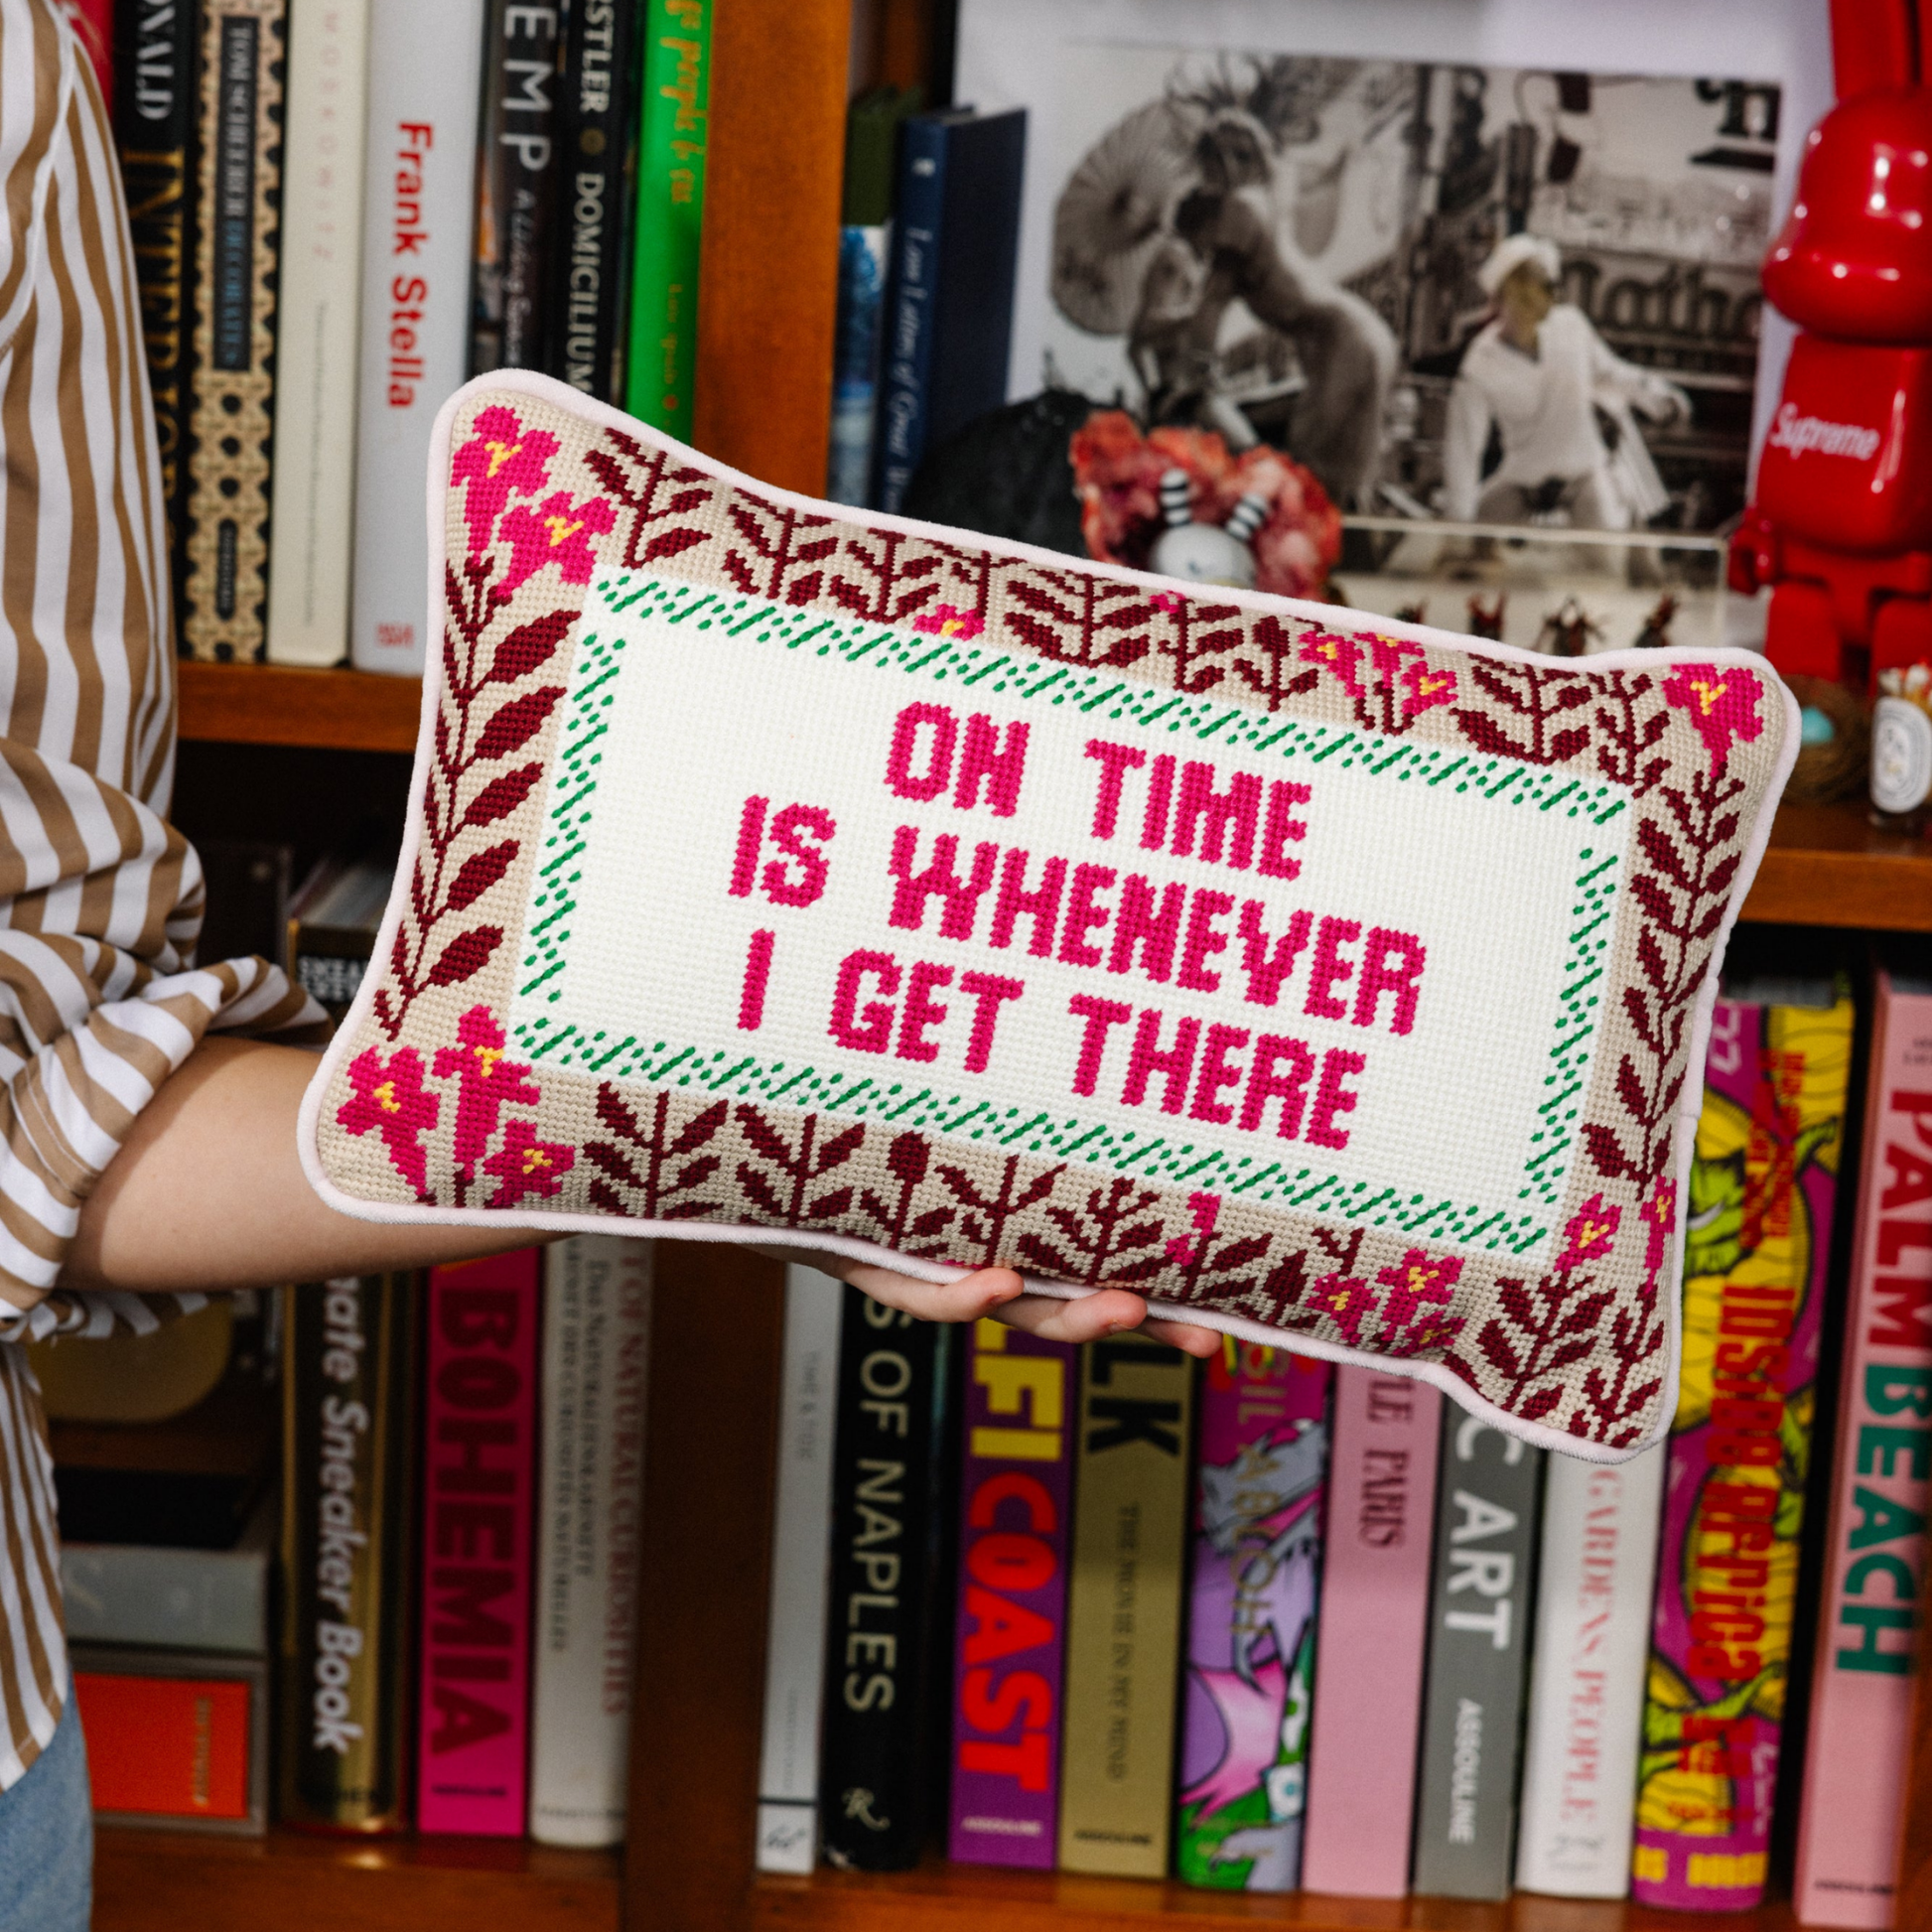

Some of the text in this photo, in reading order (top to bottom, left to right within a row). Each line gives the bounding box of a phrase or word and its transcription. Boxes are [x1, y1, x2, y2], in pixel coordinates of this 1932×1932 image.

[500, 5, 554, 171] EMP
[387, 122, 434, 409] Frank Stella
[566, 172, 606, 393] DOMICILIUM
[1770, 403, 1881, 461] Supreme
[885, 701, 1312, 881] ON TIME
[728, 794, 1428, 1036] IS WHENEVER
[737, 928, 1368, 1151] I GET THERE
[860, 1350, 912, 1438] OF
[1836, 1089, 1932, 1677] PALM BEACH
[319, 1396, 370, 1612] Sneaker
[431, 1290, 522, 1755] BOHEMIA
[844, 1457, 907, 1713] NAPLES
[1228, 1443, 1284, 1636] ABLOH
[1358, 1449, 1411, 1550] PARIS
[1443, 1489, 1518, 1651] ART
[314, 1621, 364, 1754] Book
[960, 1470, 1058, 1793] COAST
[1449, 1698, 1483, 1845] ASSOULINE
[1560, 1669, 1609, 1823] PEOPLE
